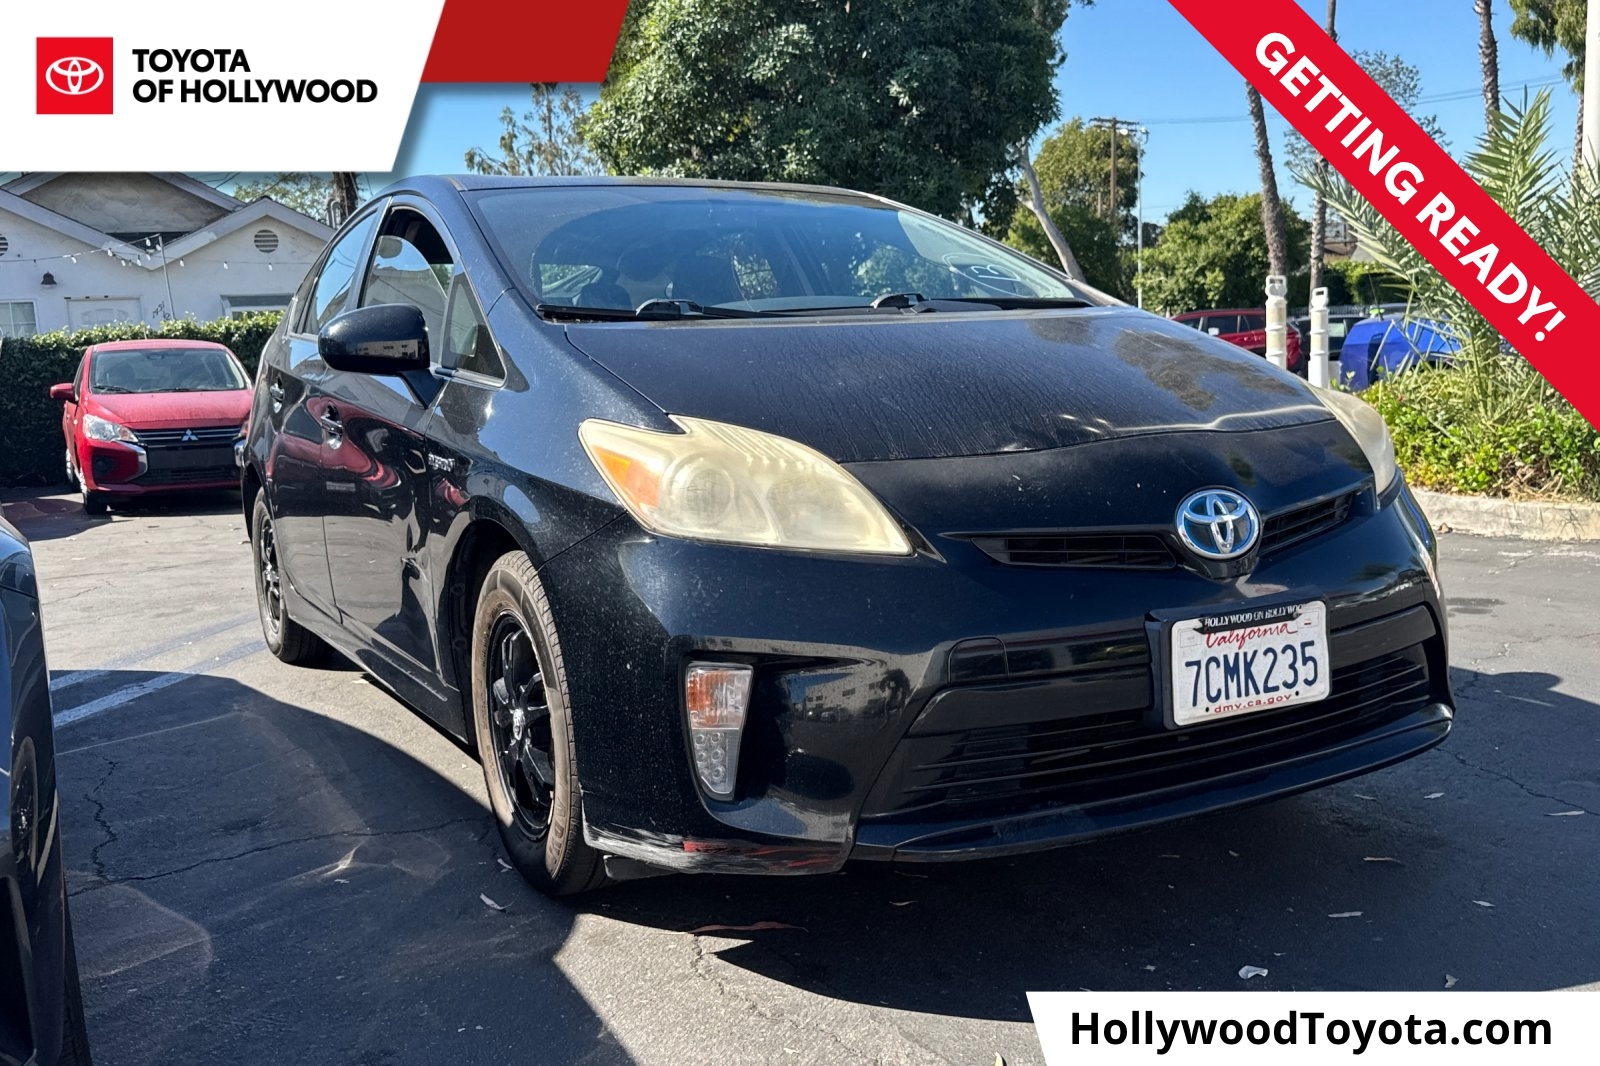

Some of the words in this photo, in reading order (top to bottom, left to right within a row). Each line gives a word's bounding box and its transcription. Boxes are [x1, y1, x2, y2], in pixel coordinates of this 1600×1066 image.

[1204, 612, 1253, 627] HOLLYWOOD
[1253, 610, 1264, 620] ON
[1205, 622, 1299, 650] California
[1184, 640, 1318, 707] 7CMK235
[1213, 693, 1293, 714] dmv.ca.gov
